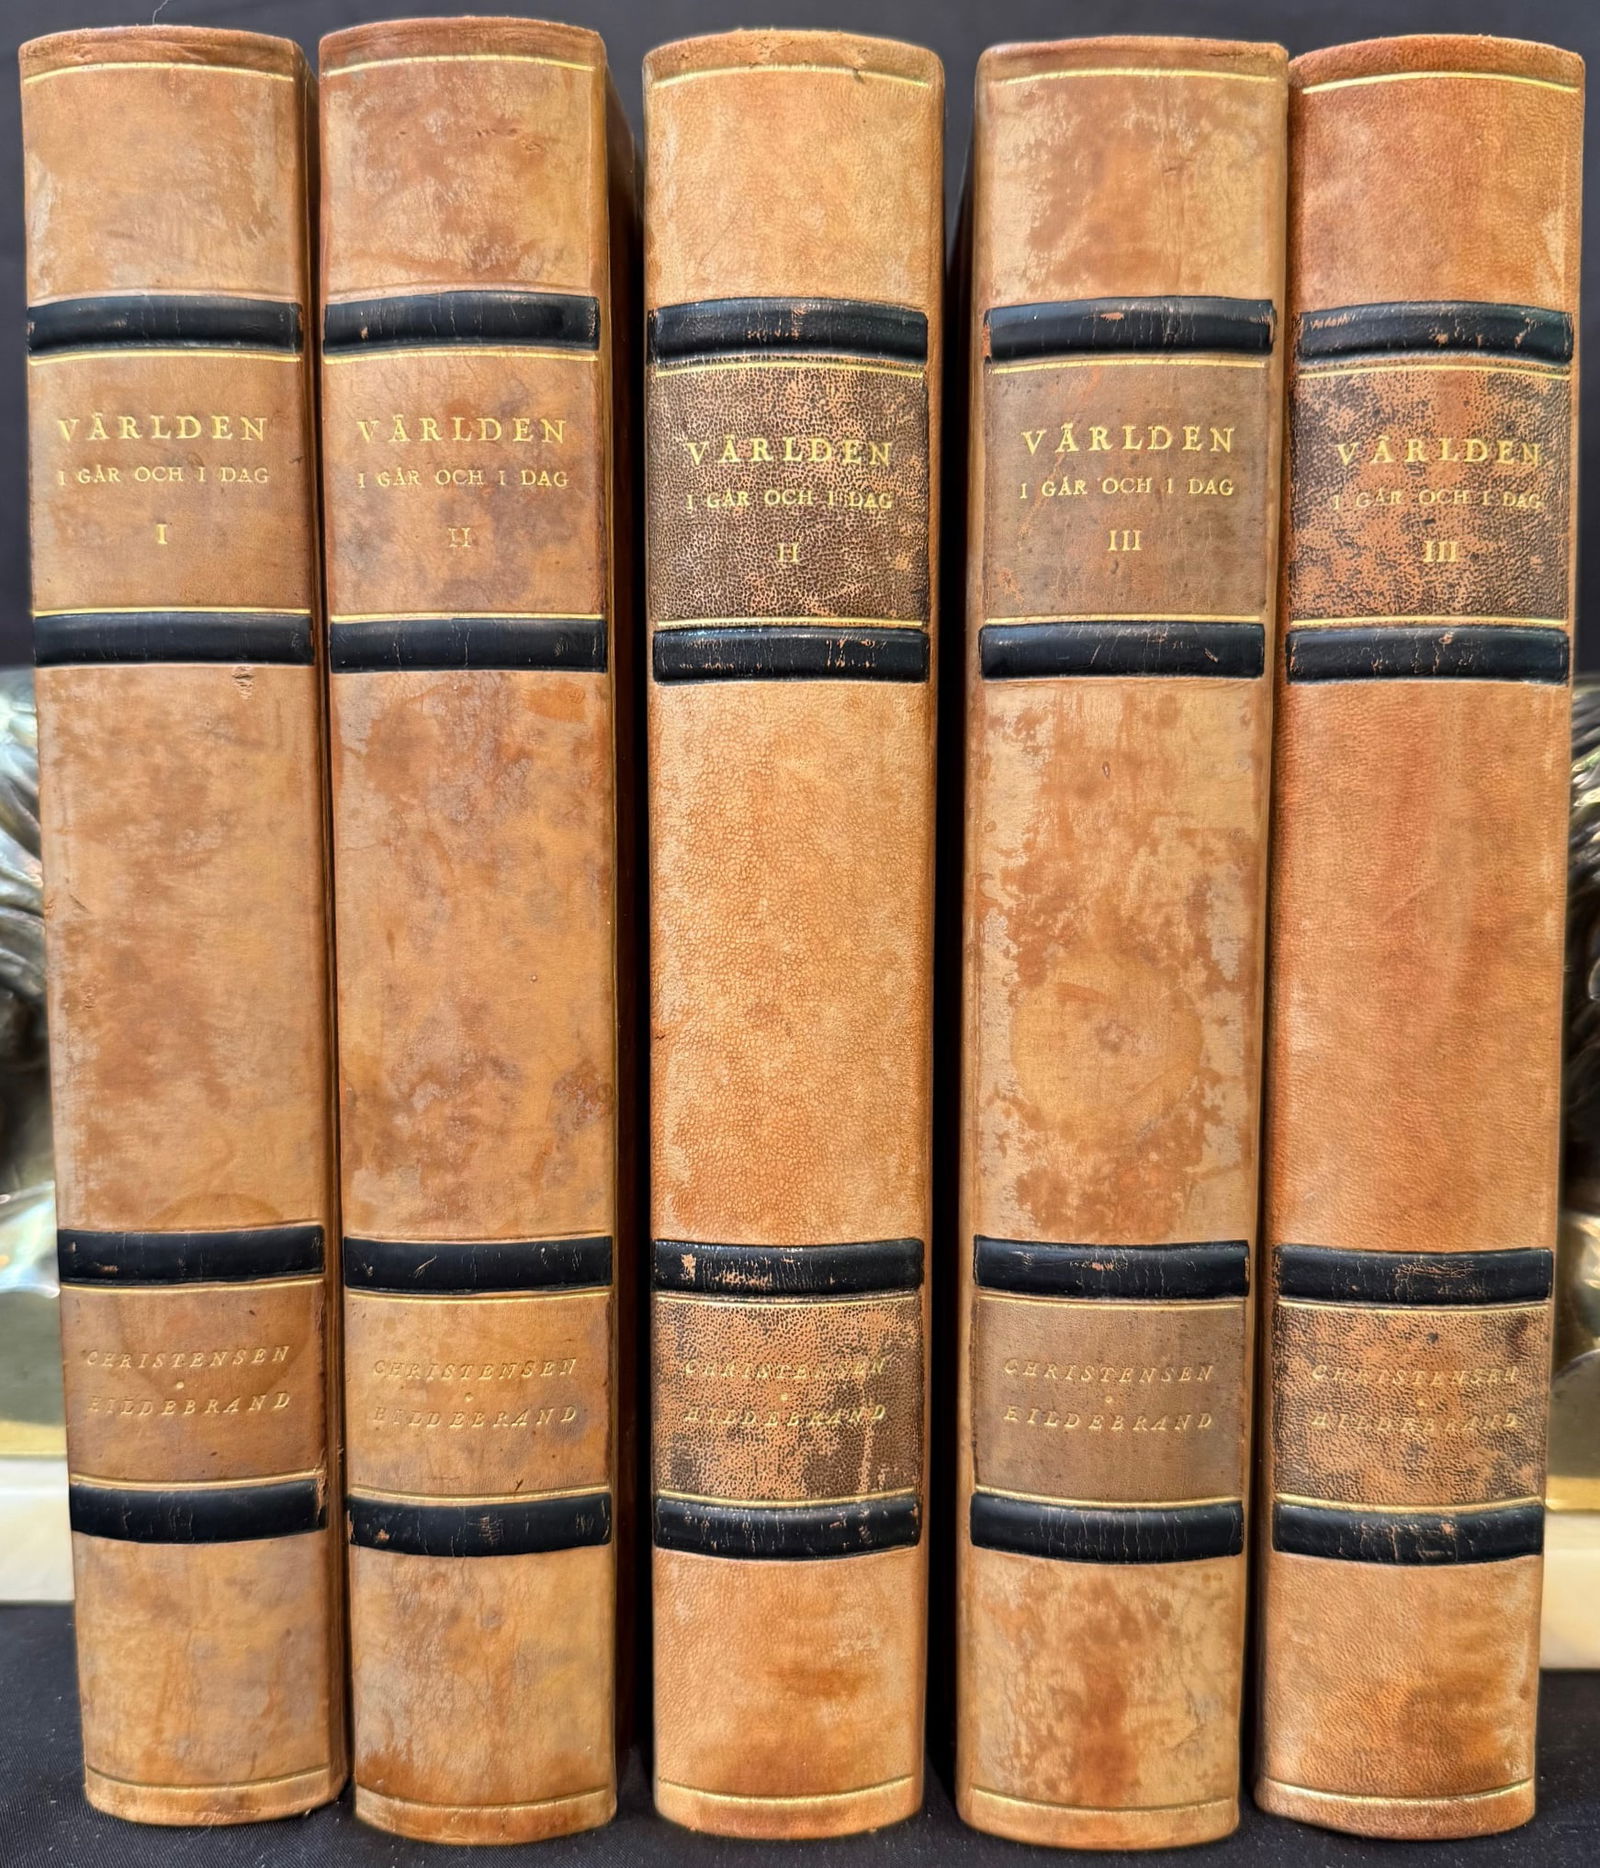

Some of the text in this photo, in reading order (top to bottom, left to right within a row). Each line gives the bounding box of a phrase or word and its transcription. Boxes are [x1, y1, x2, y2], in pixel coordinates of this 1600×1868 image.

[58, 465, 270, 486] I GÅR OCH I DAG
[358, 467, 568, 489] I GÅR OCH I DAG
[1019, 477, 1234, 499] I GÅR OCH I DAG
[686, 494, 694, 515] I
[764, 489, 814, 506] OCH
[828, 491, 836, 507] I
[849, 491, 893, 509] DAG
[1332, 495, 1341, 510] I
[1419, 489, 1469, 505] OCH
[1482, 492, 1492, 506] I
[1503, 491, 1542, 510] DAG
[156, 523, 168, 544] I
[448, 527, 471, 547] II
[1107, 529, 1142, 551] III
[776, 543, 800, 563] II
[1423, 540, 1458, 563] III
[86, 1345, 290, 1368] CHRISTENSEN
[373, 1358, 576, 1381] CHRISTENSEN
[1004, 1358, 1213, 1383] CHRISTENSEN
[373, 1405, 577, 1428] HILDEBRAND
[685, 1404, 886, 1426] HILDEBRAND
[1003, 1405, 1213, 1432] HILDEBRAND
